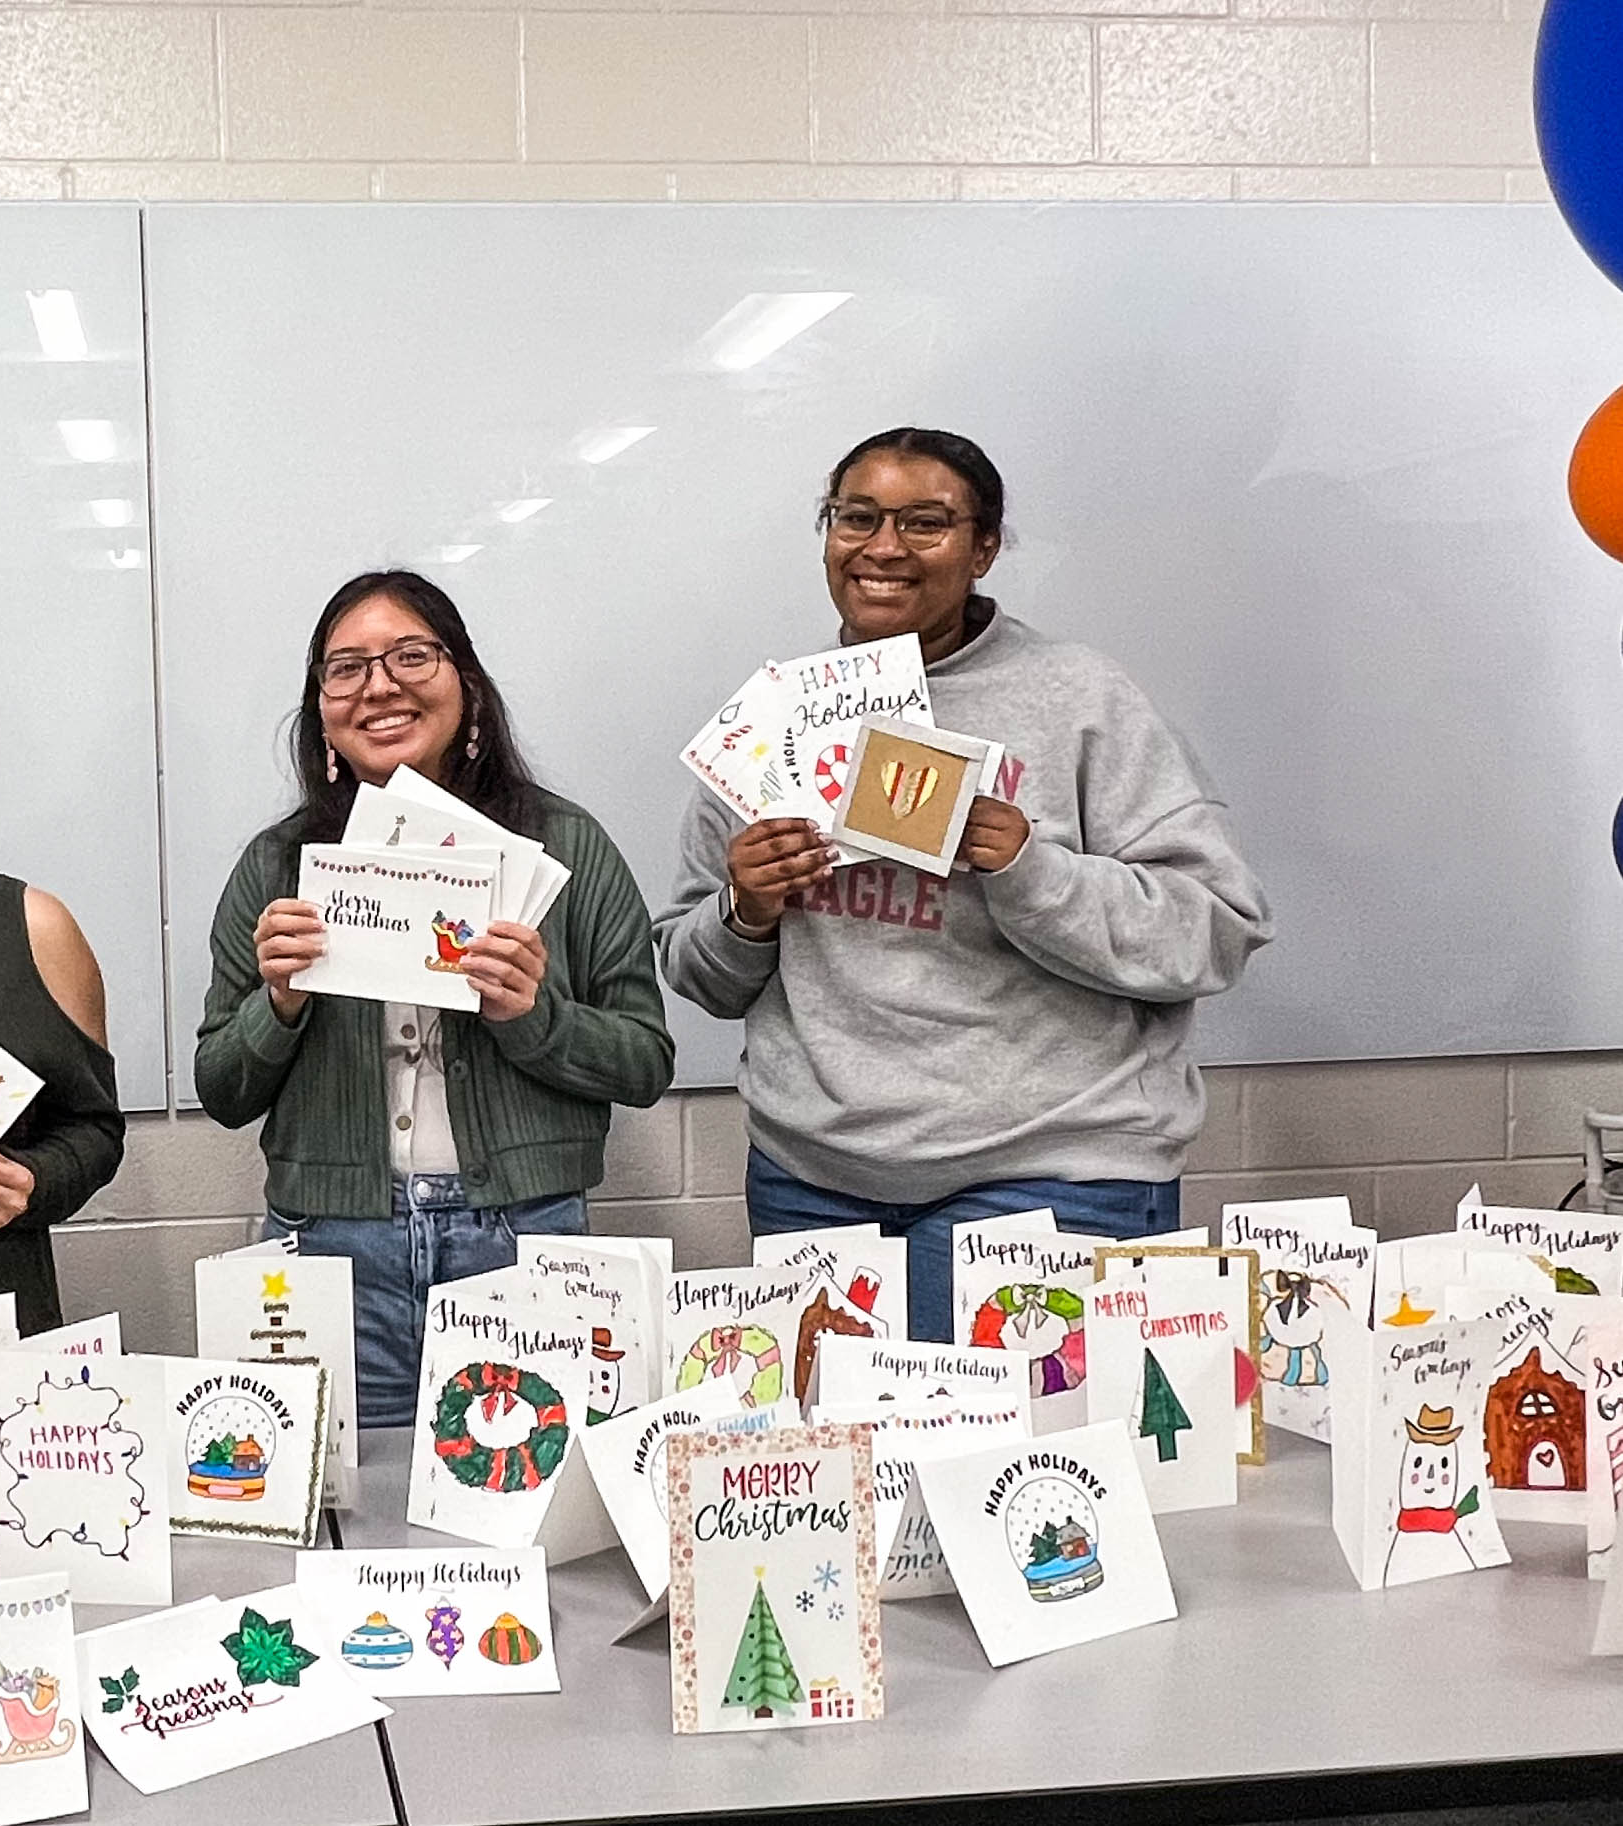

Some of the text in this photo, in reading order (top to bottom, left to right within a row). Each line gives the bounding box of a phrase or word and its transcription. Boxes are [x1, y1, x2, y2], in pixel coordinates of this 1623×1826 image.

[800, 650, 882, 693] HAPPY
[794, 676, 927, 735] Holidays!
[325, 905, 410, 933] Christmas
[331, 890, 381, 914] Merry
[784, 866, 948, 930] AGLE
[959, 1234, 1094, 1278] Happy Holida
[1227, 1215, 1369, 1268] Happy Holidays
[1463, 1213, 1620, 1256] Happy Holidays
[668, 1280, 801, 1319] Happy Holidays
[1094, 1291, 1149, 1316] MERRY
[431, 1299, 586, 1359] Happy Holidays
[872, 1351, 1008, 1383] Happy Holidays
[176, 1374, 294, 1429] HAPPY HOLIDAYS
[30, 1426, 98, 1445] HAPPY
[633, 1420, 661, 1474] HAPPY
[19, 1450, 114, 1475] HOLIDAYS
[723, 1460, 821, 1500] MERRY
[985, 1453, 1107, 1517] HAPPY HOLIDAYS
[695, 1497, 851, 1541] Christmas
[358, 1562, 521, 1593] Happy Holidays
[136, 1678, 227, 1717] Seasons
[142, 1691, 255, 1739] Greetings
